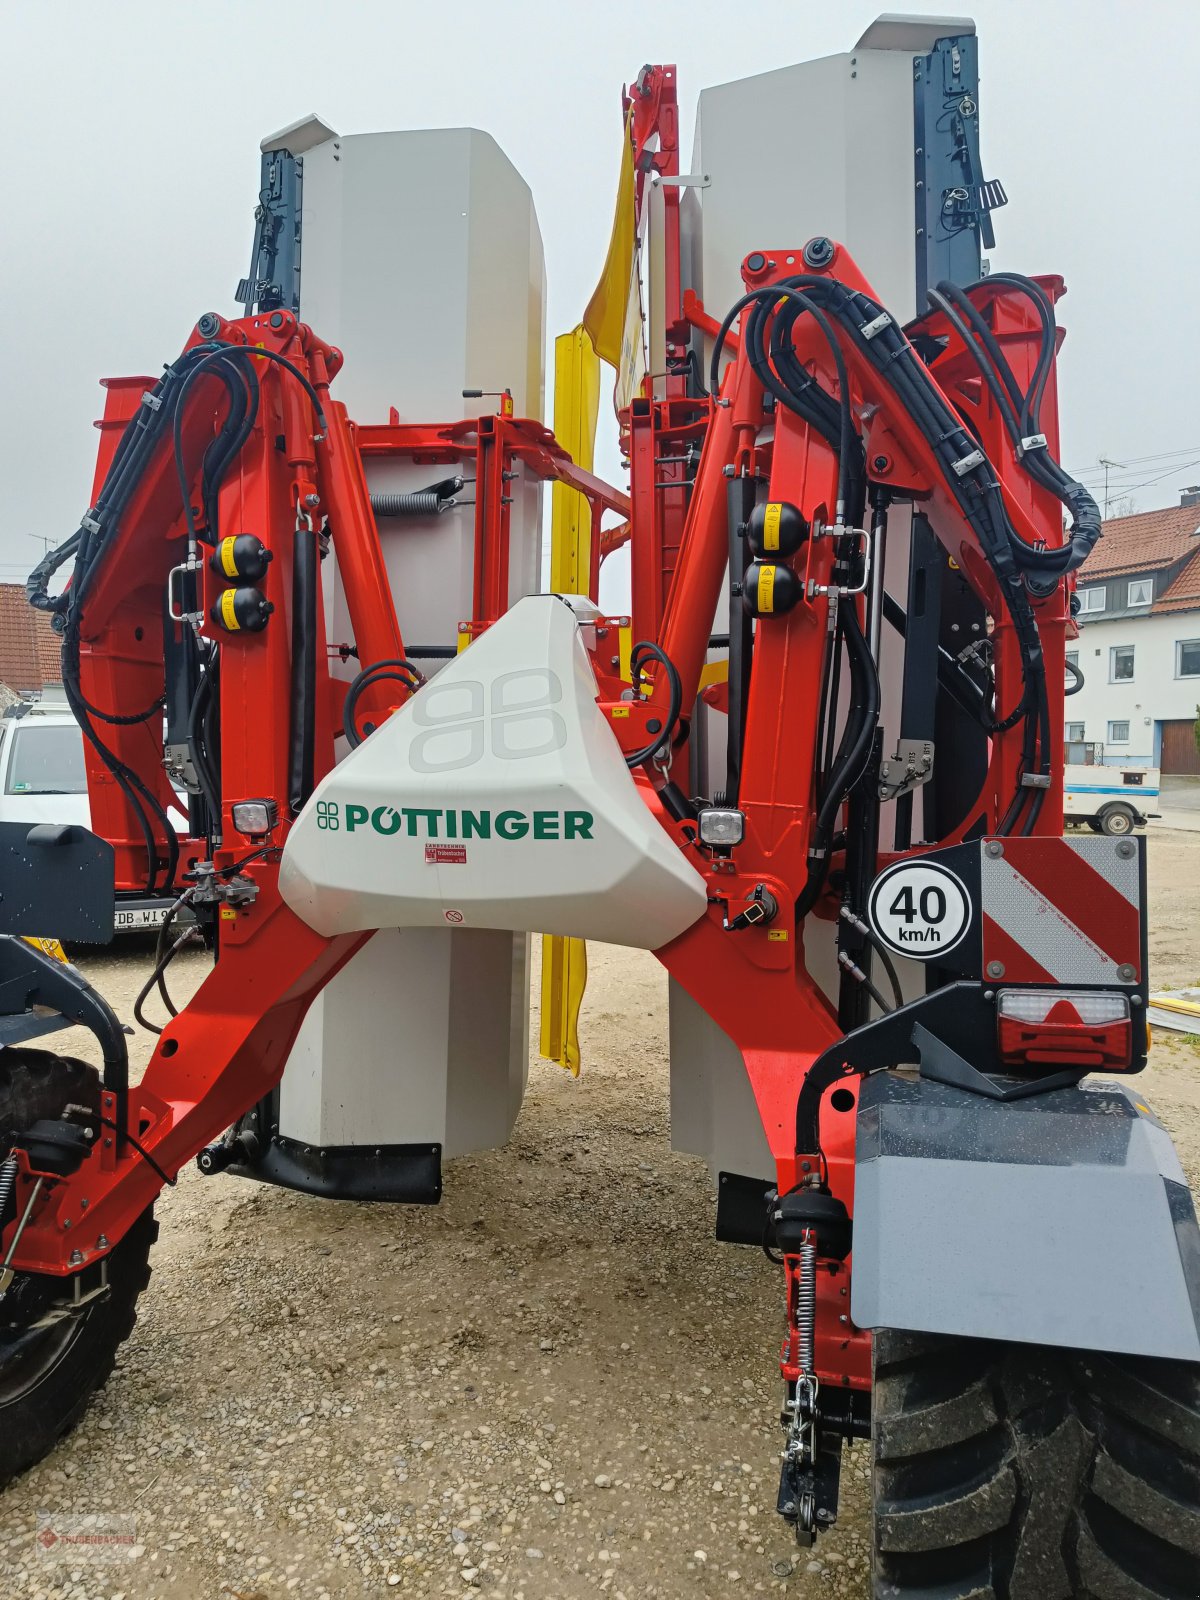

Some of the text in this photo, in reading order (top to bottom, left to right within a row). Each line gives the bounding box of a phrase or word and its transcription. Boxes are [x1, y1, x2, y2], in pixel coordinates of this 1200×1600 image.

[346, 804, 594, 840] PÖTTINGER
[142, 911, 157, 922] WI
[889, 886, 947, 924] 40
[898, 927, 941, 942] km/h
